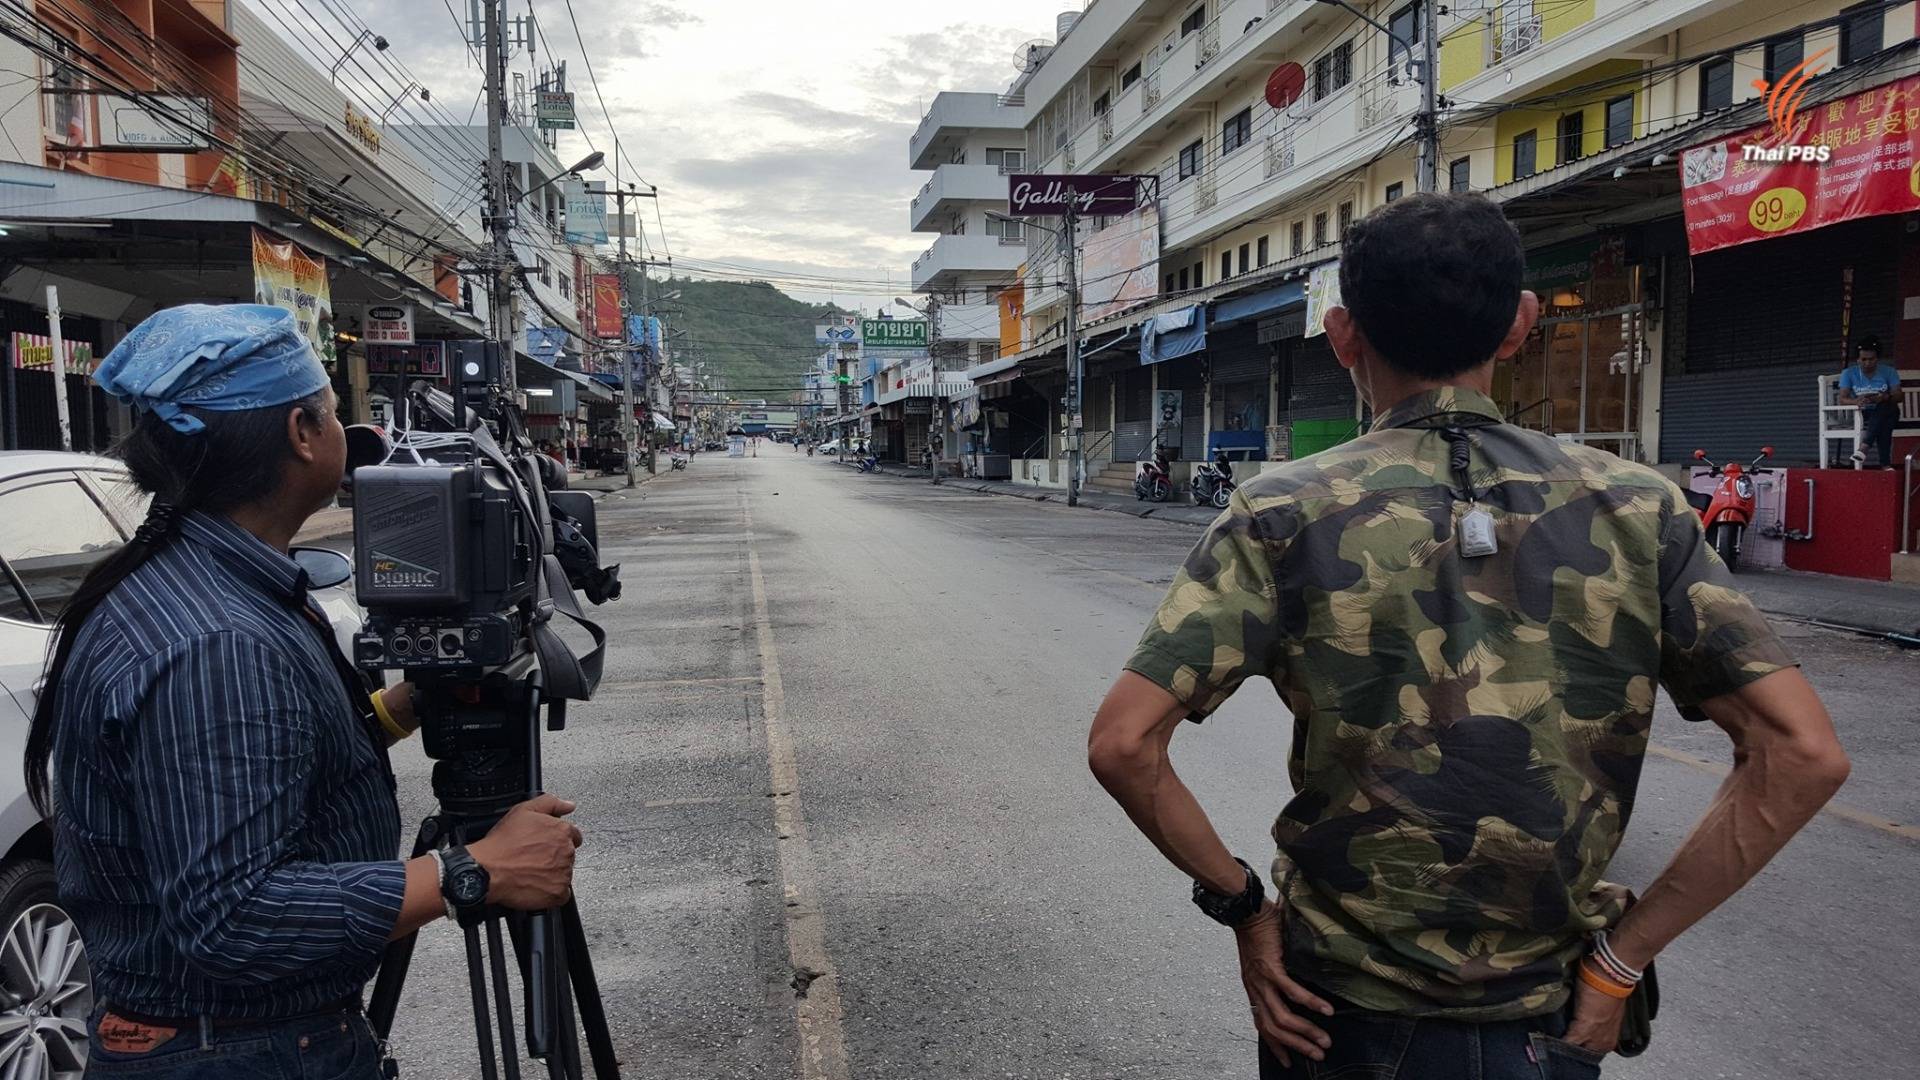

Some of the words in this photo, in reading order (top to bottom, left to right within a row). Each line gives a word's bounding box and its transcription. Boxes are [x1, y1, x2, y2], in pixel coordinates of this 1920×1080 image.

[1834, 151, 1871, 167] massage
[1833, 166, 1868, 182] massage
[568, 204, 604, 214] Lotus
[1755, 197, 1783, 226] 99
[865, 322, 925, 337] ขายยา
